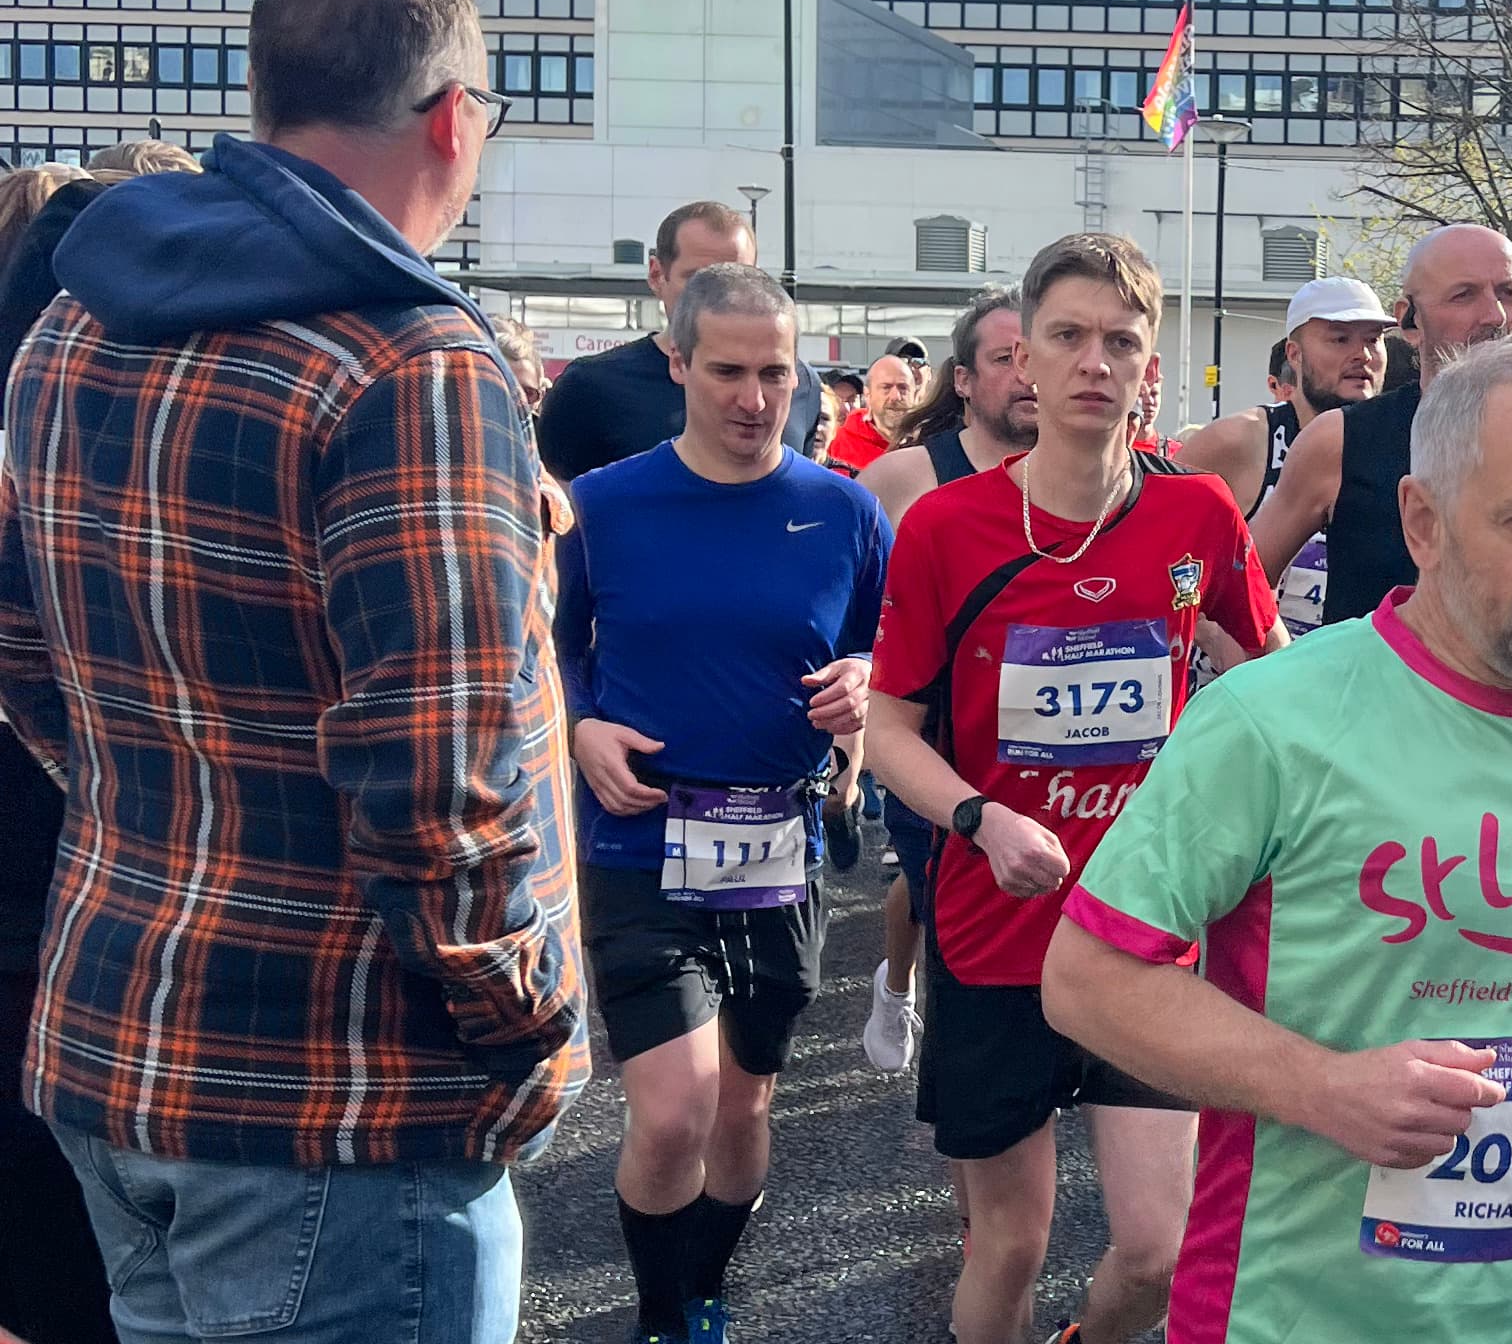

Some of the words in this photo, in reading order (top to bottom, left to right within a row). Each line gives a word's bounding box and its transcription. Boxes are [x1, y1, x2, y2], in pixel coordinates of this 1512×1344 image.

[1085, 646, 1135, 658] MARATHON
[1034, 679, 1145, 718] 3173
[1065, 726, 1110, 739] JACOB
[1358, 836, 1467, 944] St
[1400, 1237, 1424, 1250] FOR
[1426, 1240, 1445, 1252] ALL
